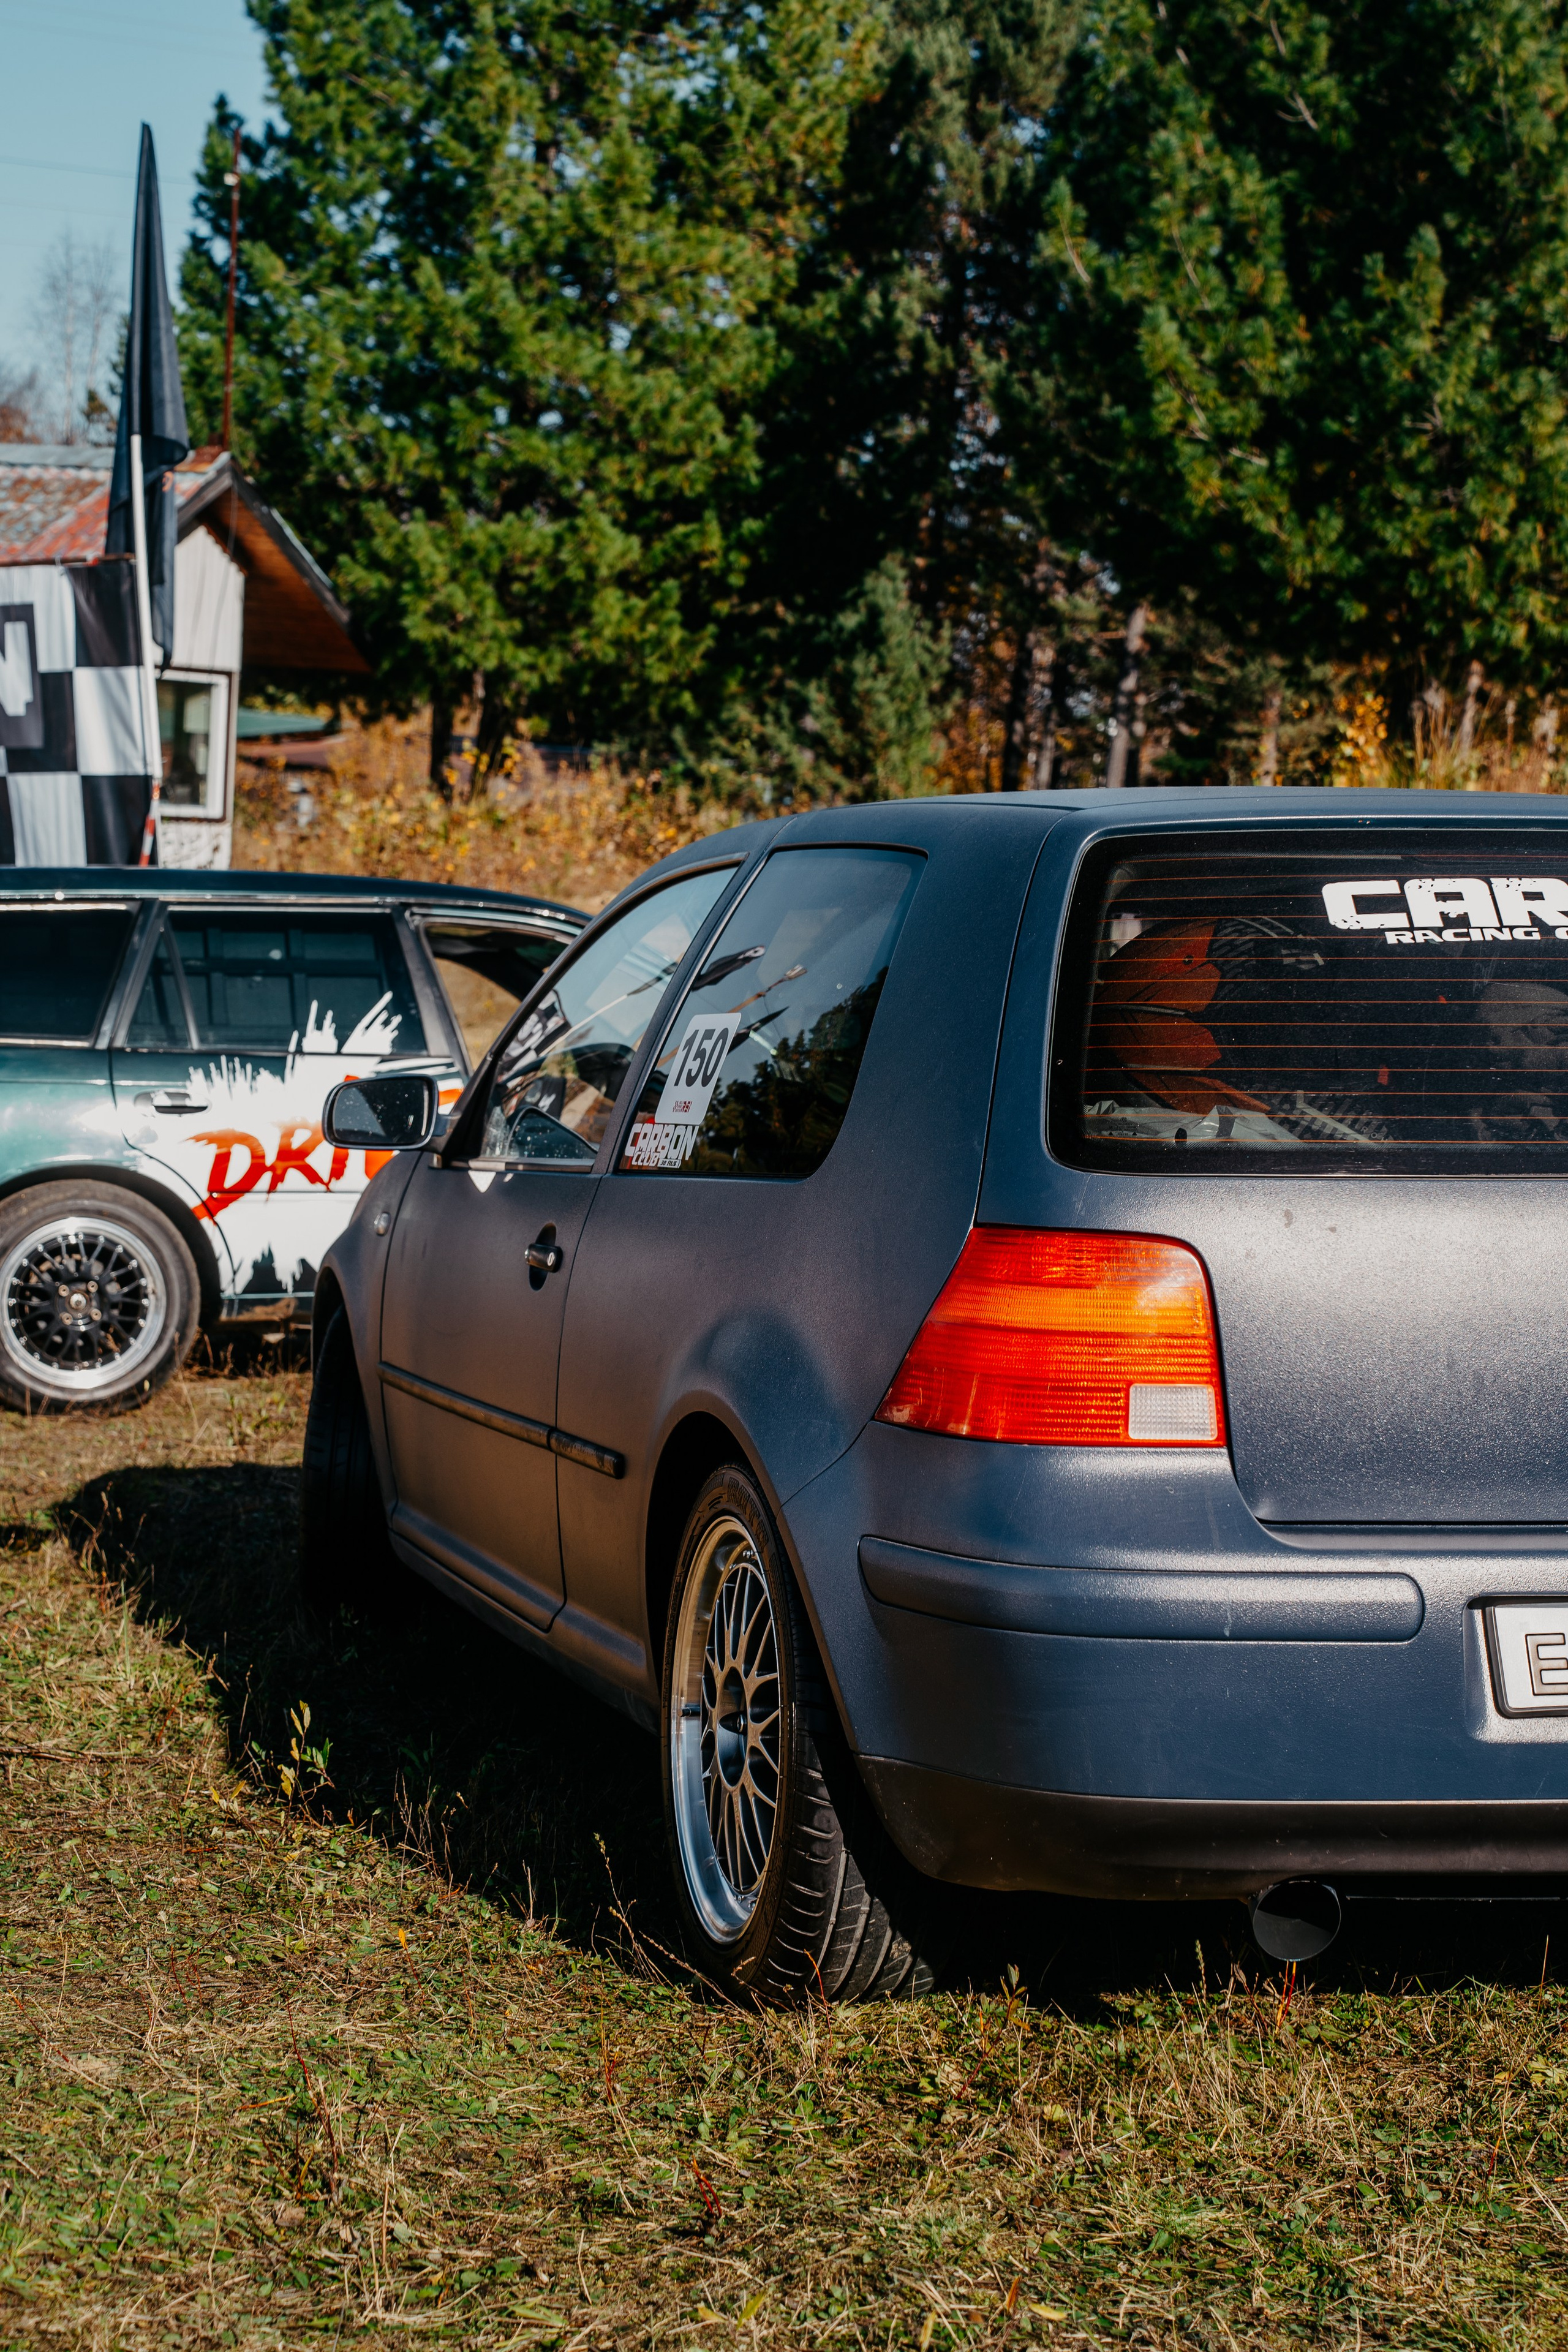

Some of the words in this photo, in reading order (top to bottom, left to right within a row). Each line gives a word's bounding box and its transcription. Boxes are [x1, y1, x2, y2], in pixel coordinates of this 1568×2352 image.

[1385, 927, 1541, 944] RACING
[674, 1027, 729, 1087] 150
[625, 1123, 699, 1161] CARBON
[631, 1152, 660, 1167] CLUB
